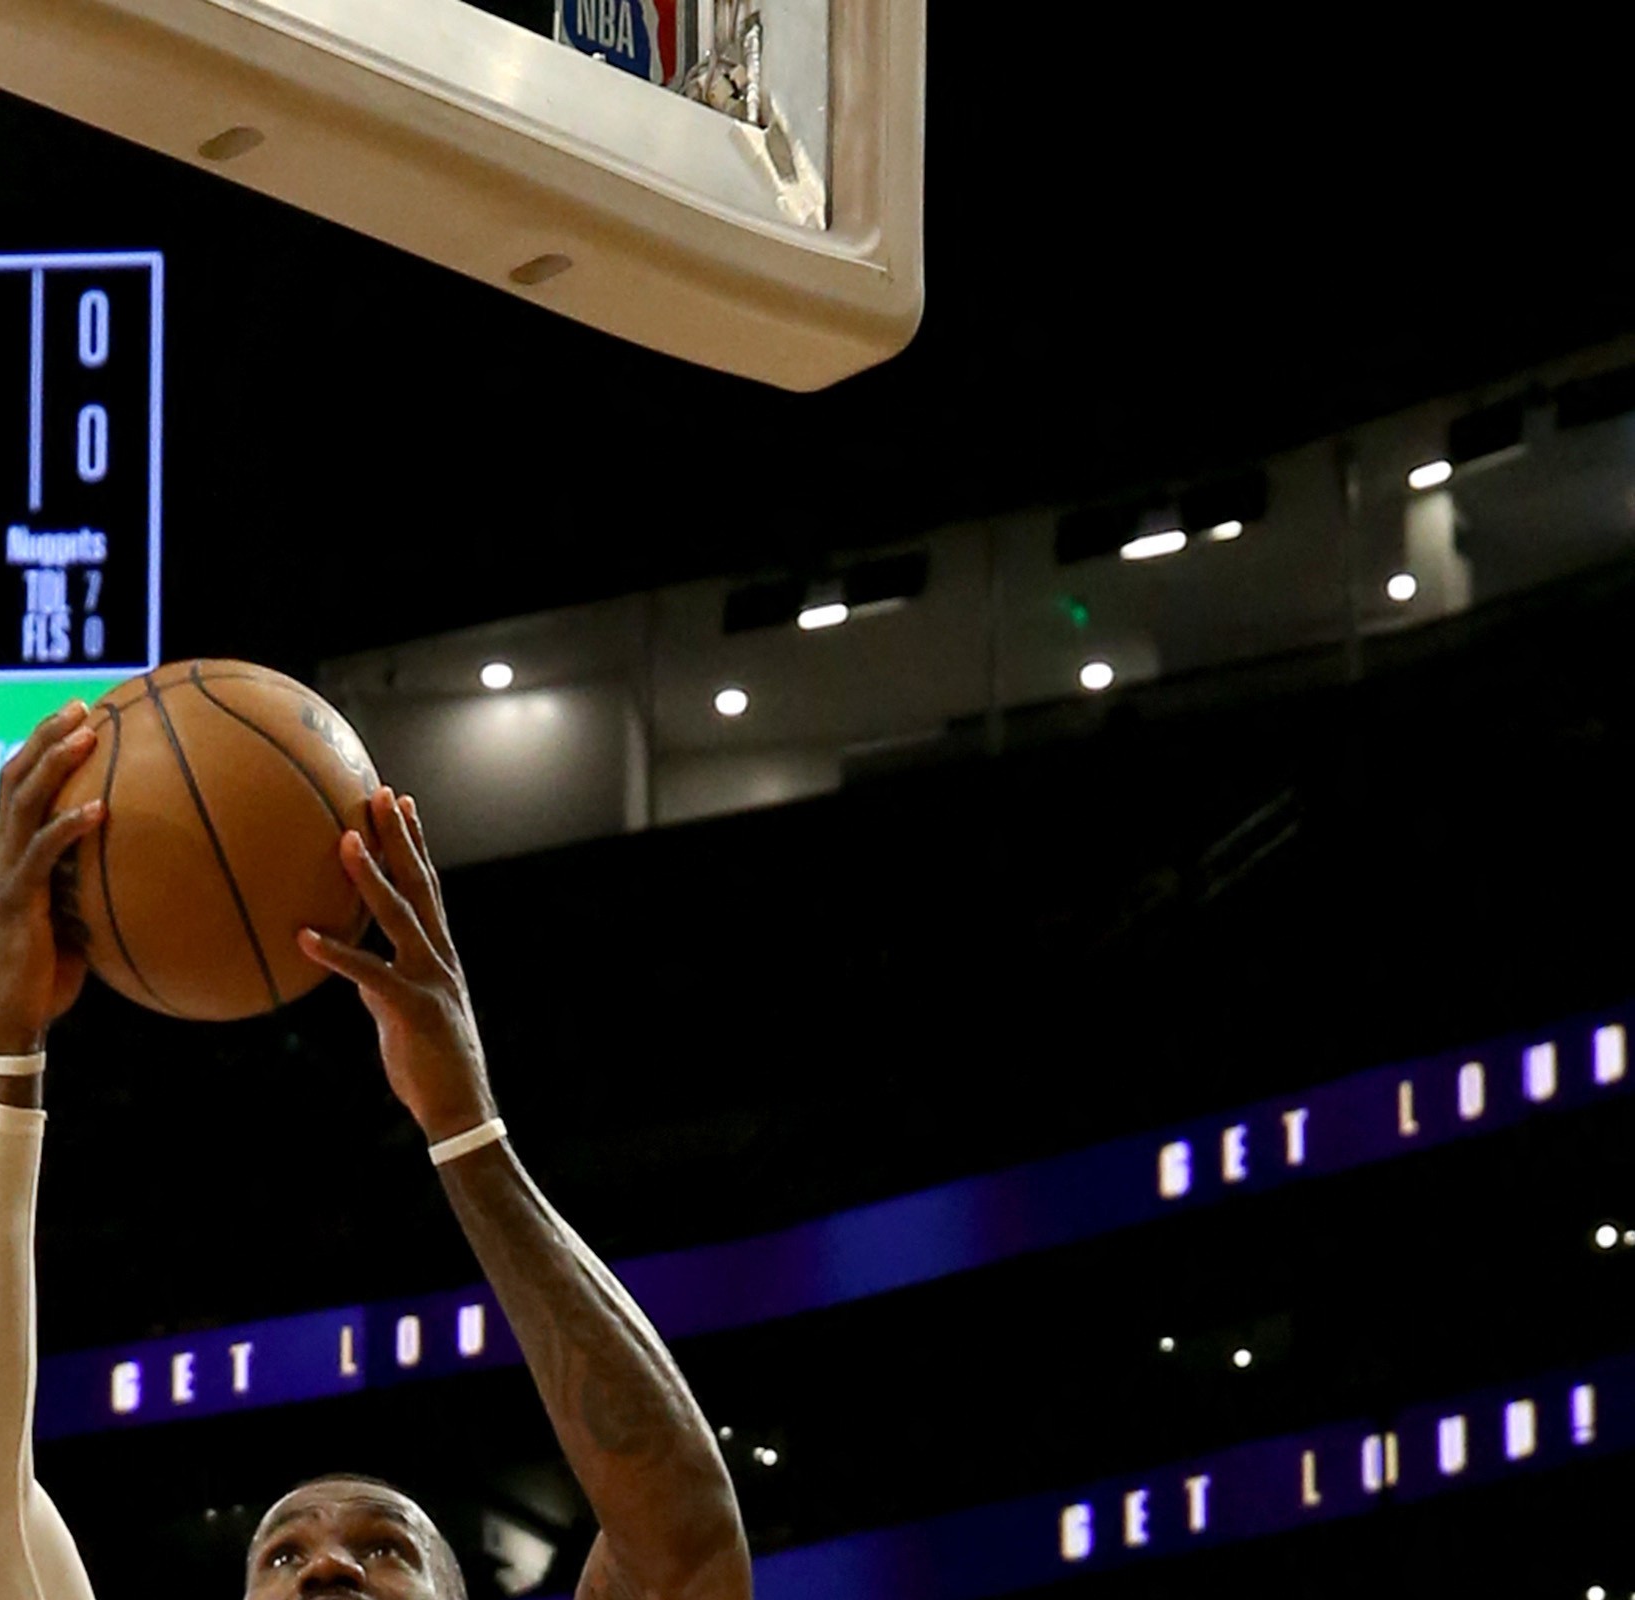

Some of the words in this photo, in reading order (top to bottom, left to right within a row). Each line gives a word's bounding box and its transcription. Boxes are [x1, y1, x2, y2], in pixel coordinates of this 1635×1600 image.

[575, 0, 637, 59] NBA
[79, 290, 108, 368] 0
[78, 404, 107, 483] 0
[1158, 1108, 1308, 1199] GET
[111, 1341, 253, 1414] GET
[339, 1304, 485, 1377] LOU
[1061, 1474, 1210, 1560] GET
